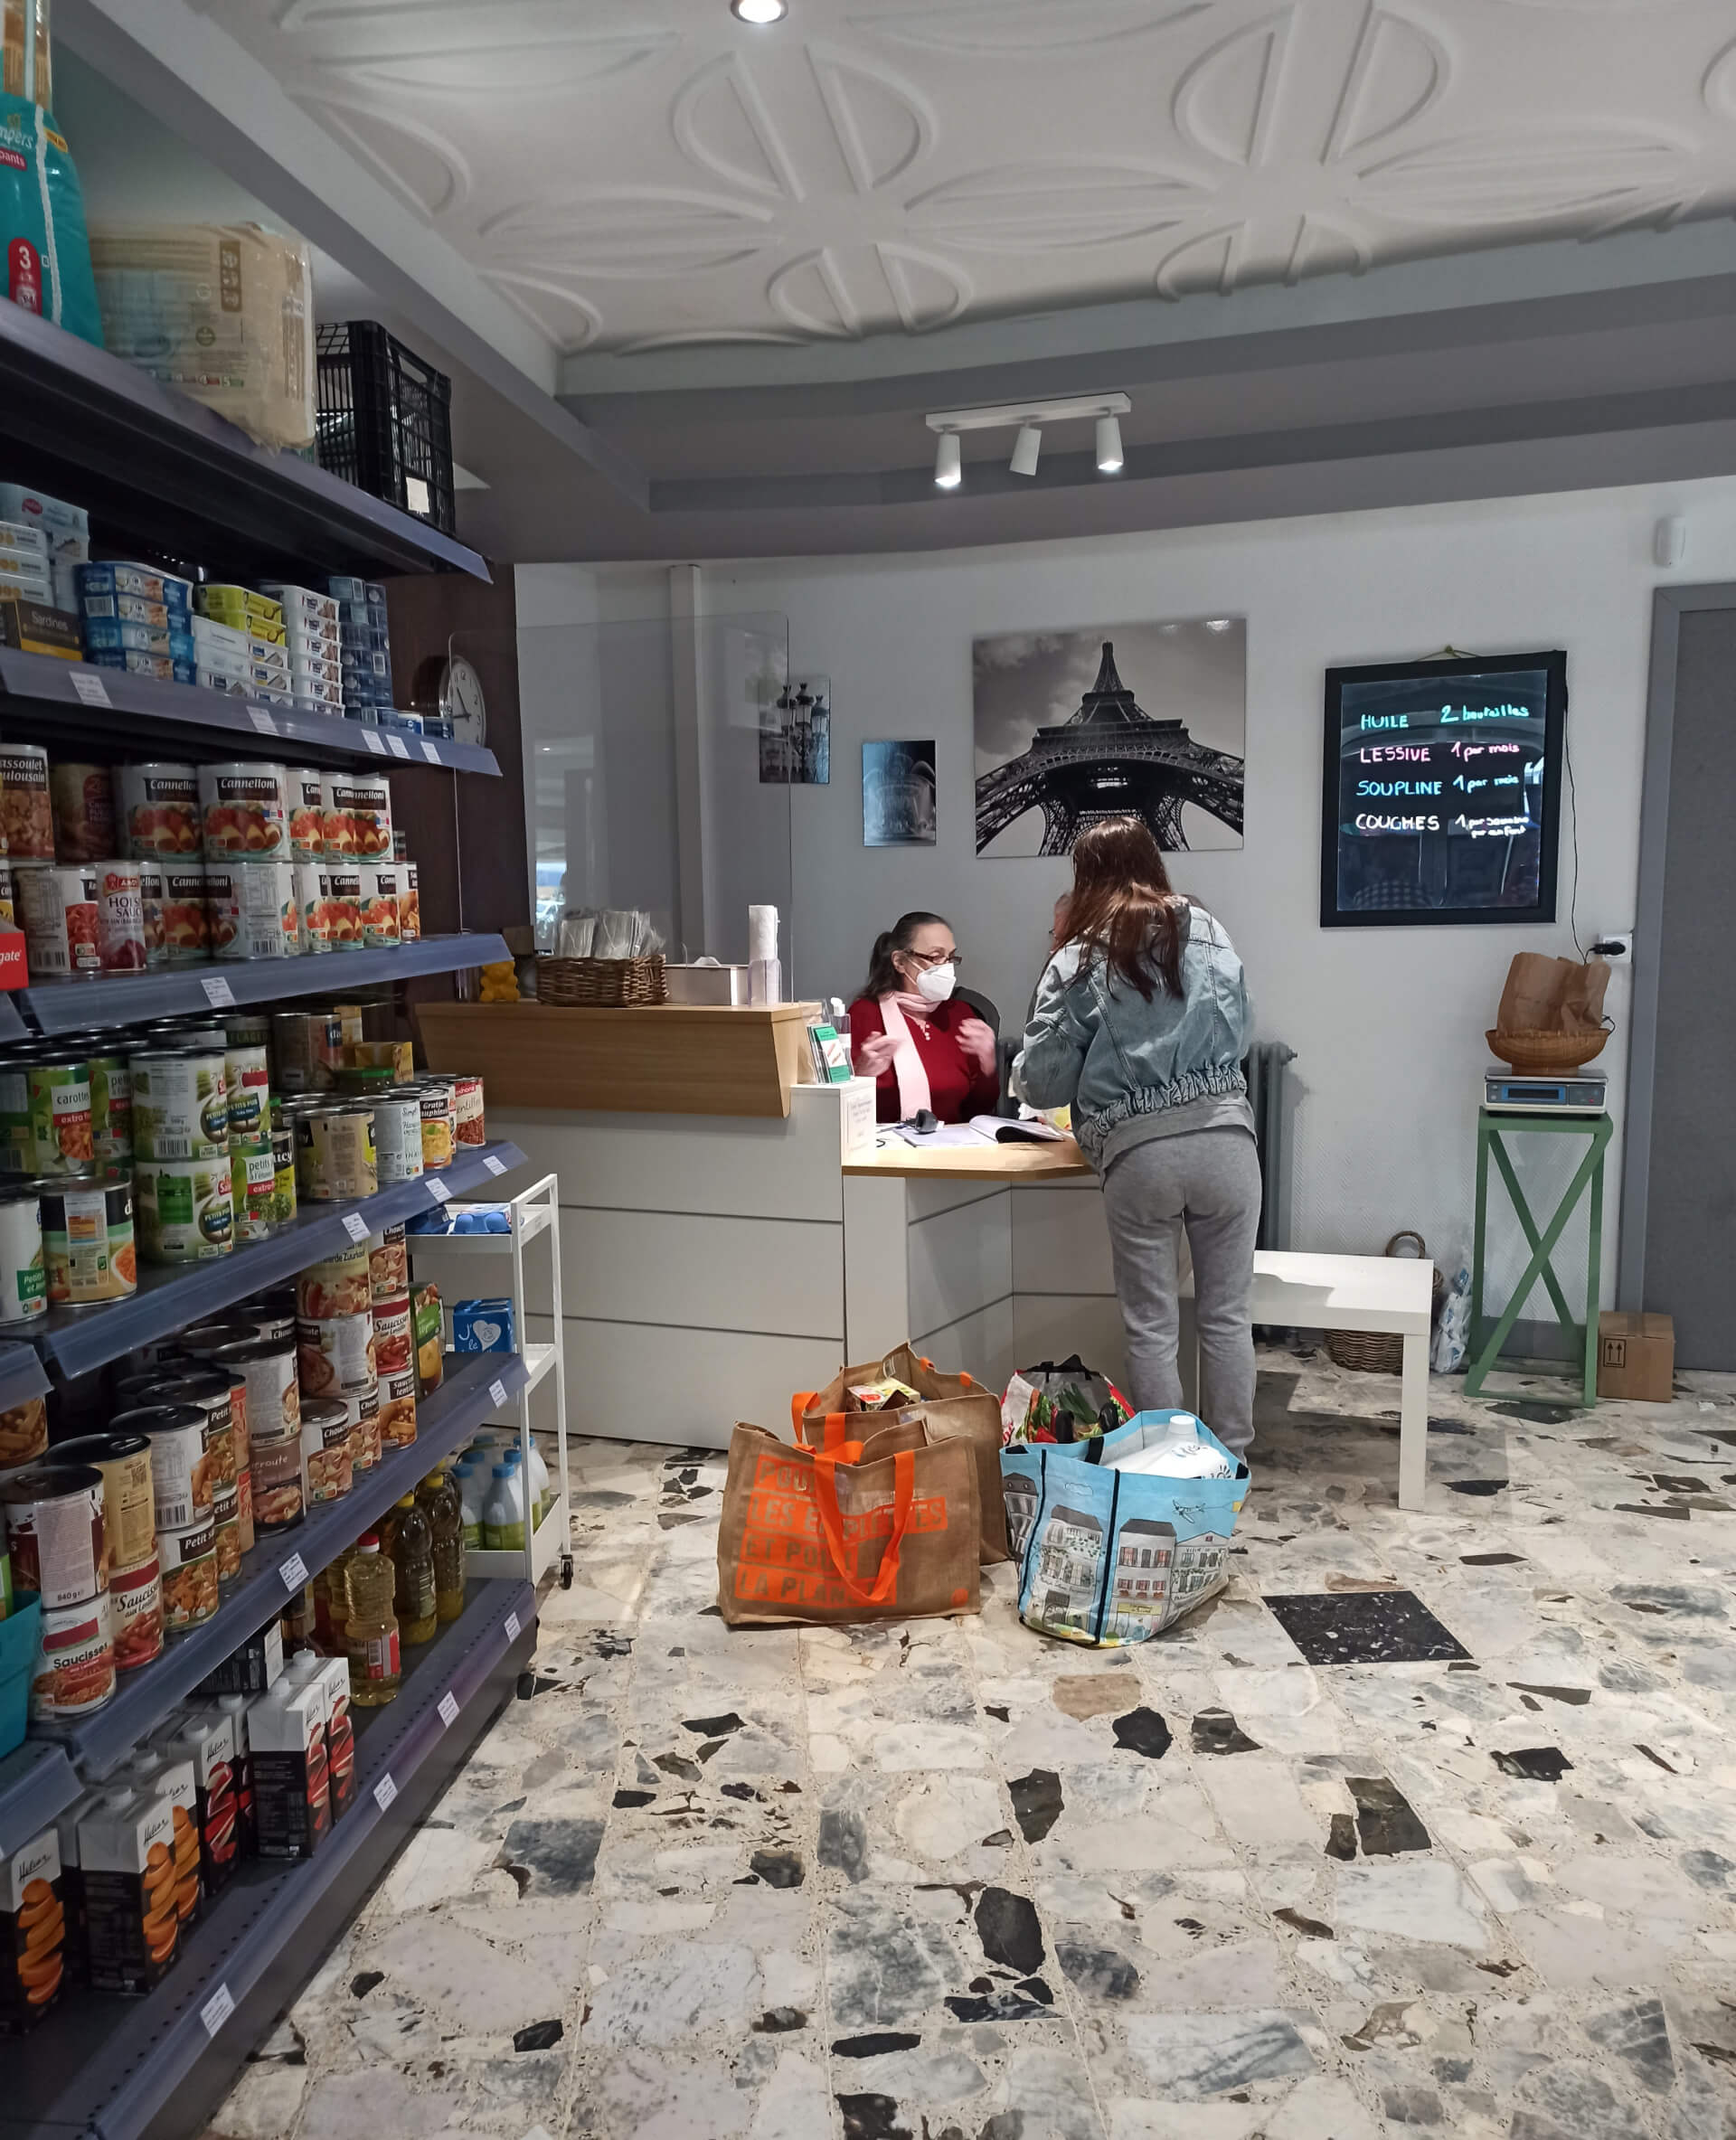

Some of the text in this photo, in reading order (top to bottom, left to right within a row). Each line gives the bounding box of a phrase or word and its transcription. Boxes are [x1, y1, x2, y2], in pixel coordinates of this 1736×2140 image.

[19, 245, 31, 269] 3
[32, 610, 69, 631] Sardines
[1360, 713, 1410, 731] HUILE
[1439, 705, 1459, 723] 2
[1360, 741, 1520, 764] LESSIVE 1 par mois
[0, 771, 45, 782] ulousain
[150, 779, 196, 791] Cannello
[221, 778, 275, 789] Cannelloni
[1355, 774, 1520, 797] SOUPLINE 1 par mois
[1455, 813, 1466, 828] 1
[61, 1113, 83, 1124] extra
[468, 1339, 478, 1350] le
[210, 1408, 229, 1422] Petit
[760, 1459, 815, 1492] POU
[751, 1494, 796, 1528] LES
[184, 1529, 207, 1551] Petit
[745, 1534, 777, 1560] ET
[740, 1570, 769, 1597] LA
